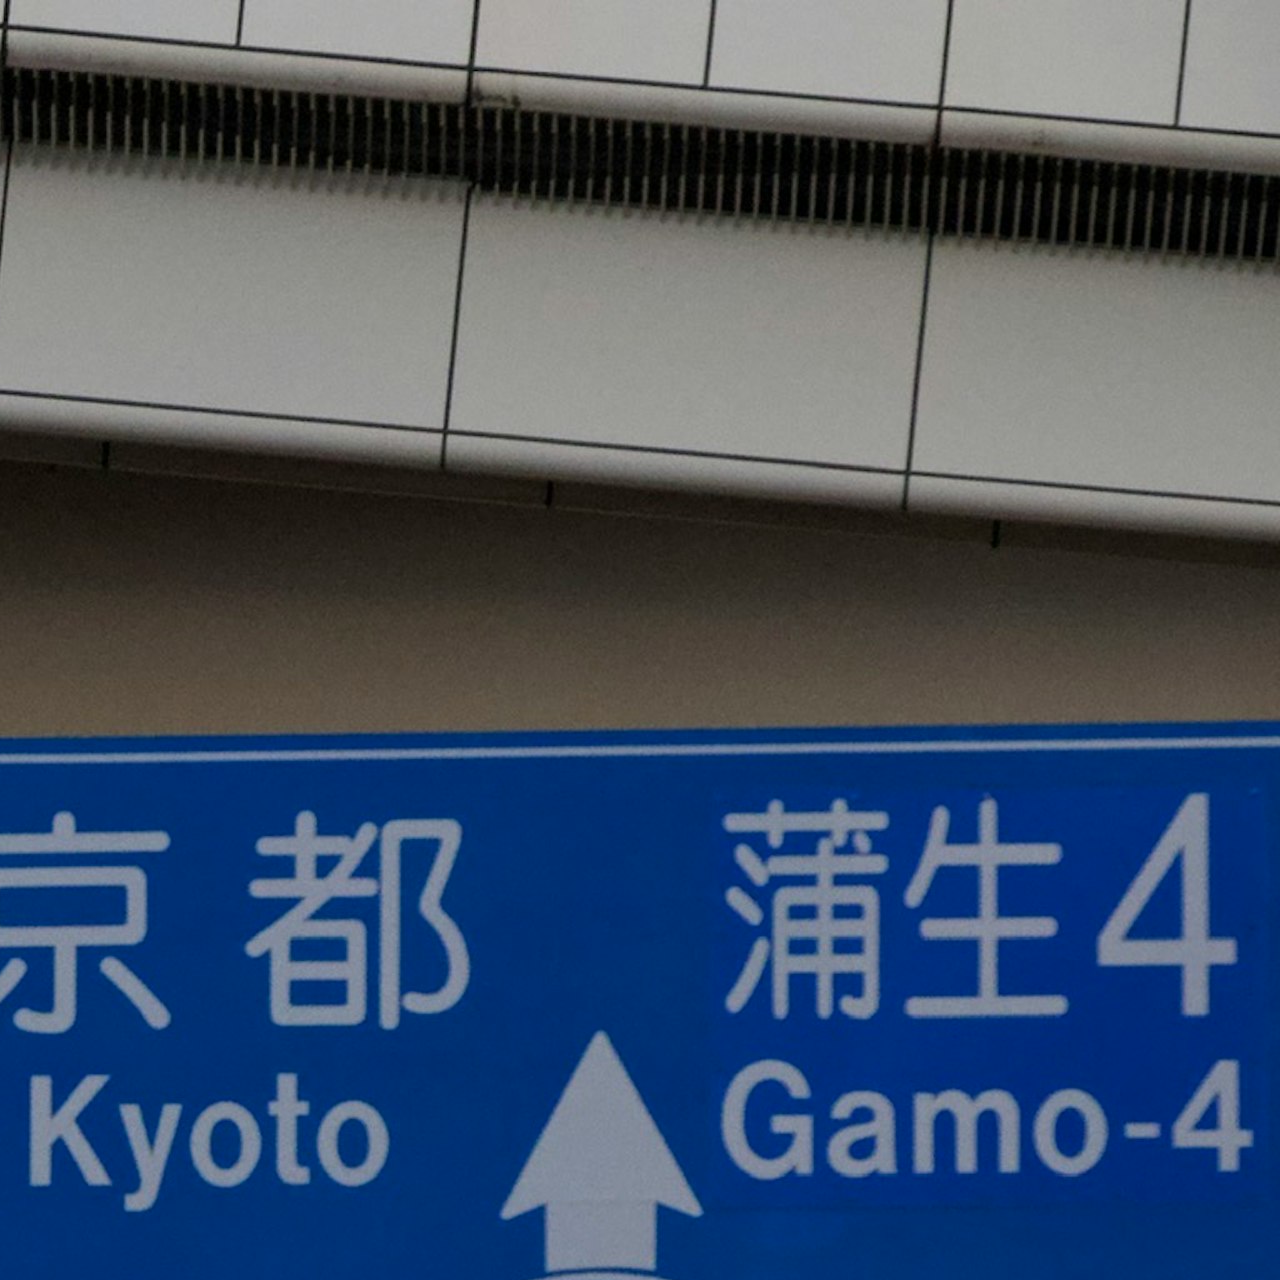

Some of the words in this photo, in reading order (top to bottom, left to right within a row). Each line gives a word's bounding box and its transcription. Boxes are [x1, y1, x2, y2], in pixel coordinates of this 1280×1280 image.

[725, 794, 1236, 1019] 蒲生4
[31, 1074, 388, 1211] Kyoto
[722, 1060, 1252, 1179] Gamo-4
